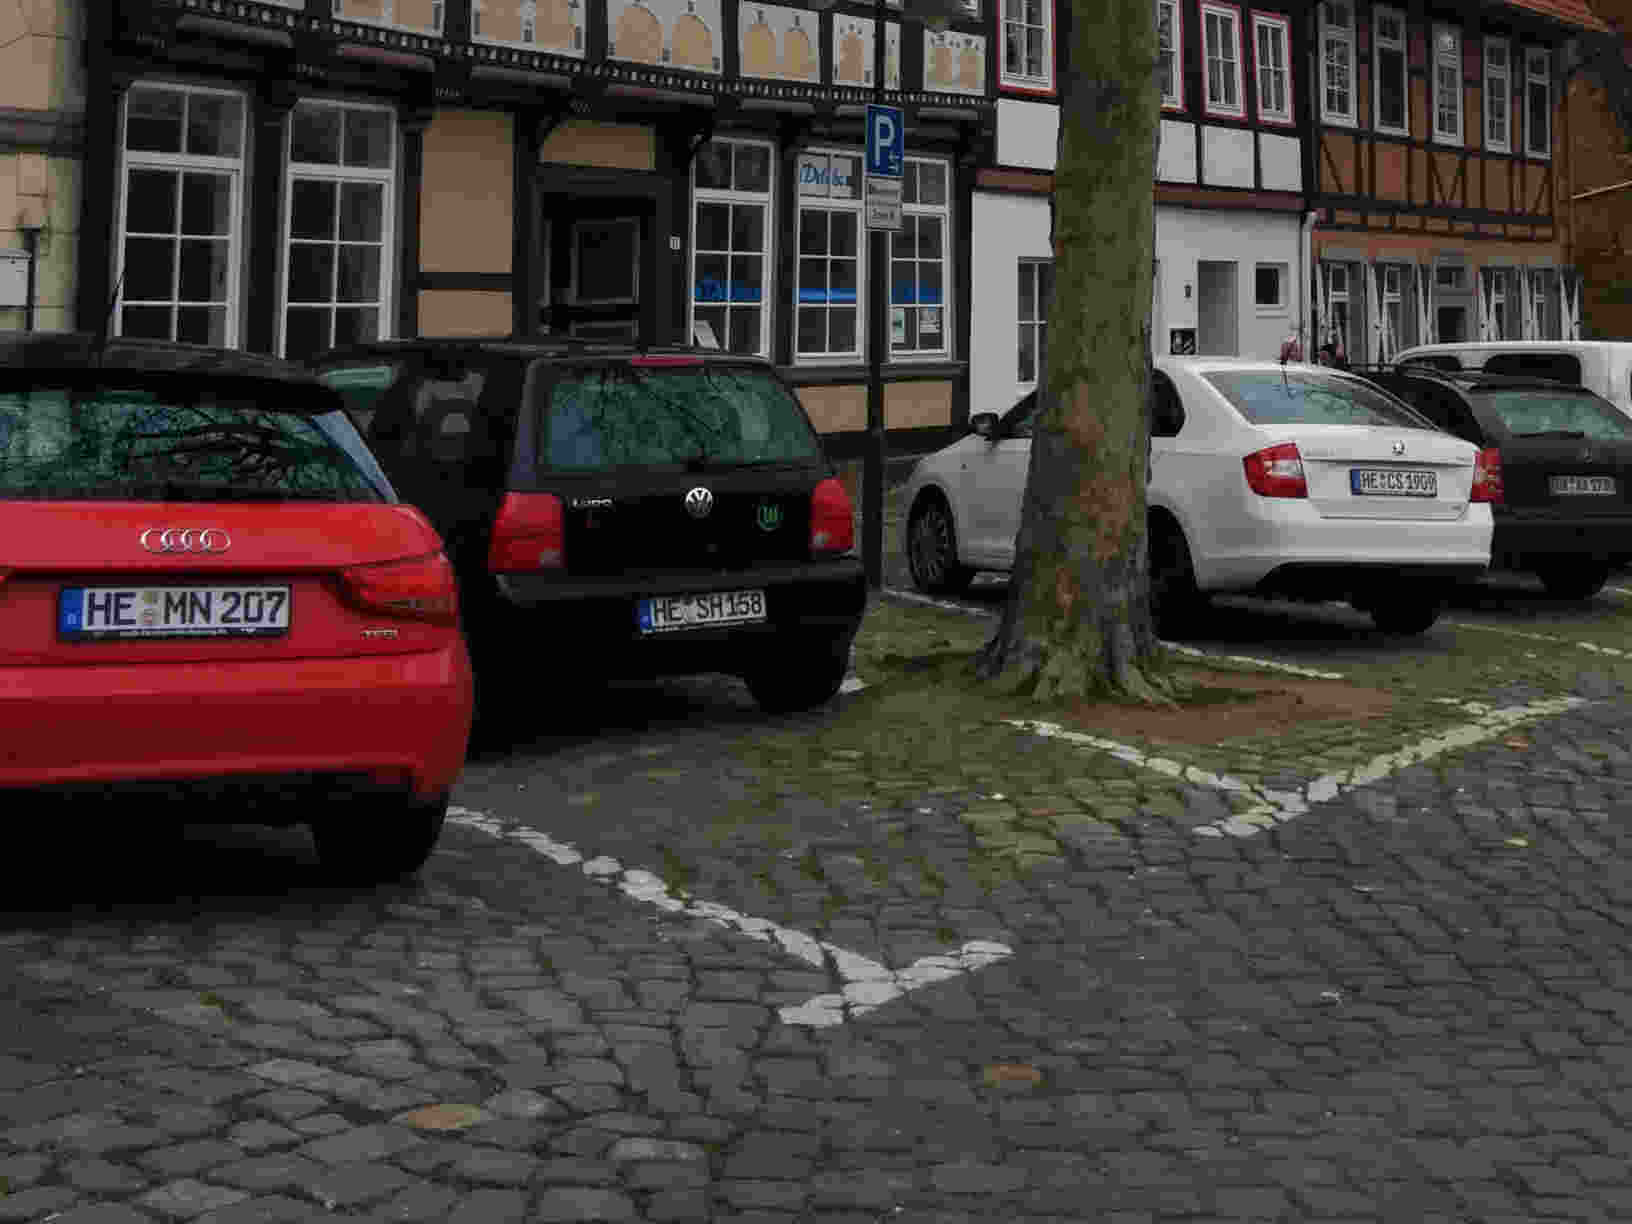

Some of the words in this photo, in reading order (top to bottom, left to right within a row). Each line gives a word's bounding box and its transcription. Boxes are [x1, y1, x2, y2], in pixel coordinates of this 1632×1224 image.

[875, 113, 895, 167] P
[1361, 472, 1378, 489] HE
[86, 591, 137, 625] HE
[164, 590, 212, 625] MN
[220, 590, 286, 624] 207
[654, 598, 683, 624] HE
